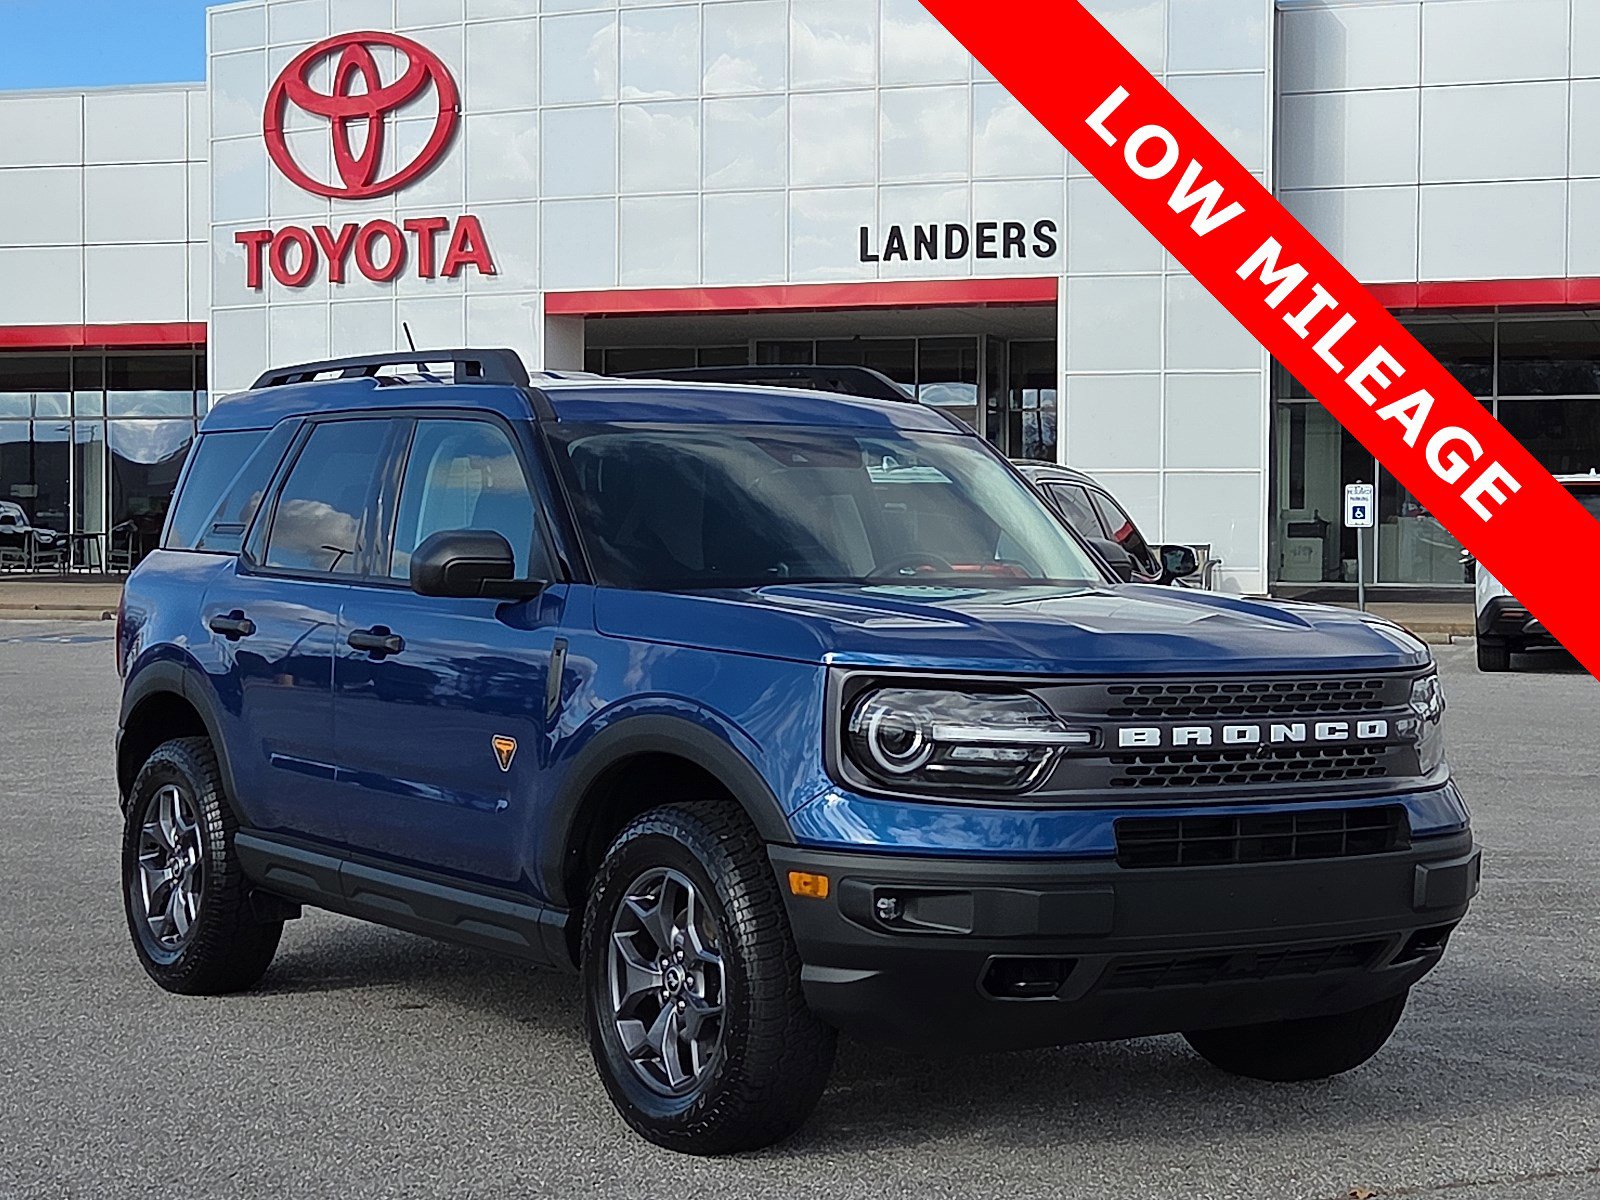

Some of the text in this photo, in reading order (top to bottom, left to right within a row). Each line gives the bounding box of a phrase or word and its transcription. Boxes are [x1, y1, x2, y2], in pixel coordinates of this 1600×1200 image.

[235, 215, 496, 288] TOYOTA
[859, 219, 1057, 263] LANDERS
[1118, 720, 1388, 747] BRONCO
